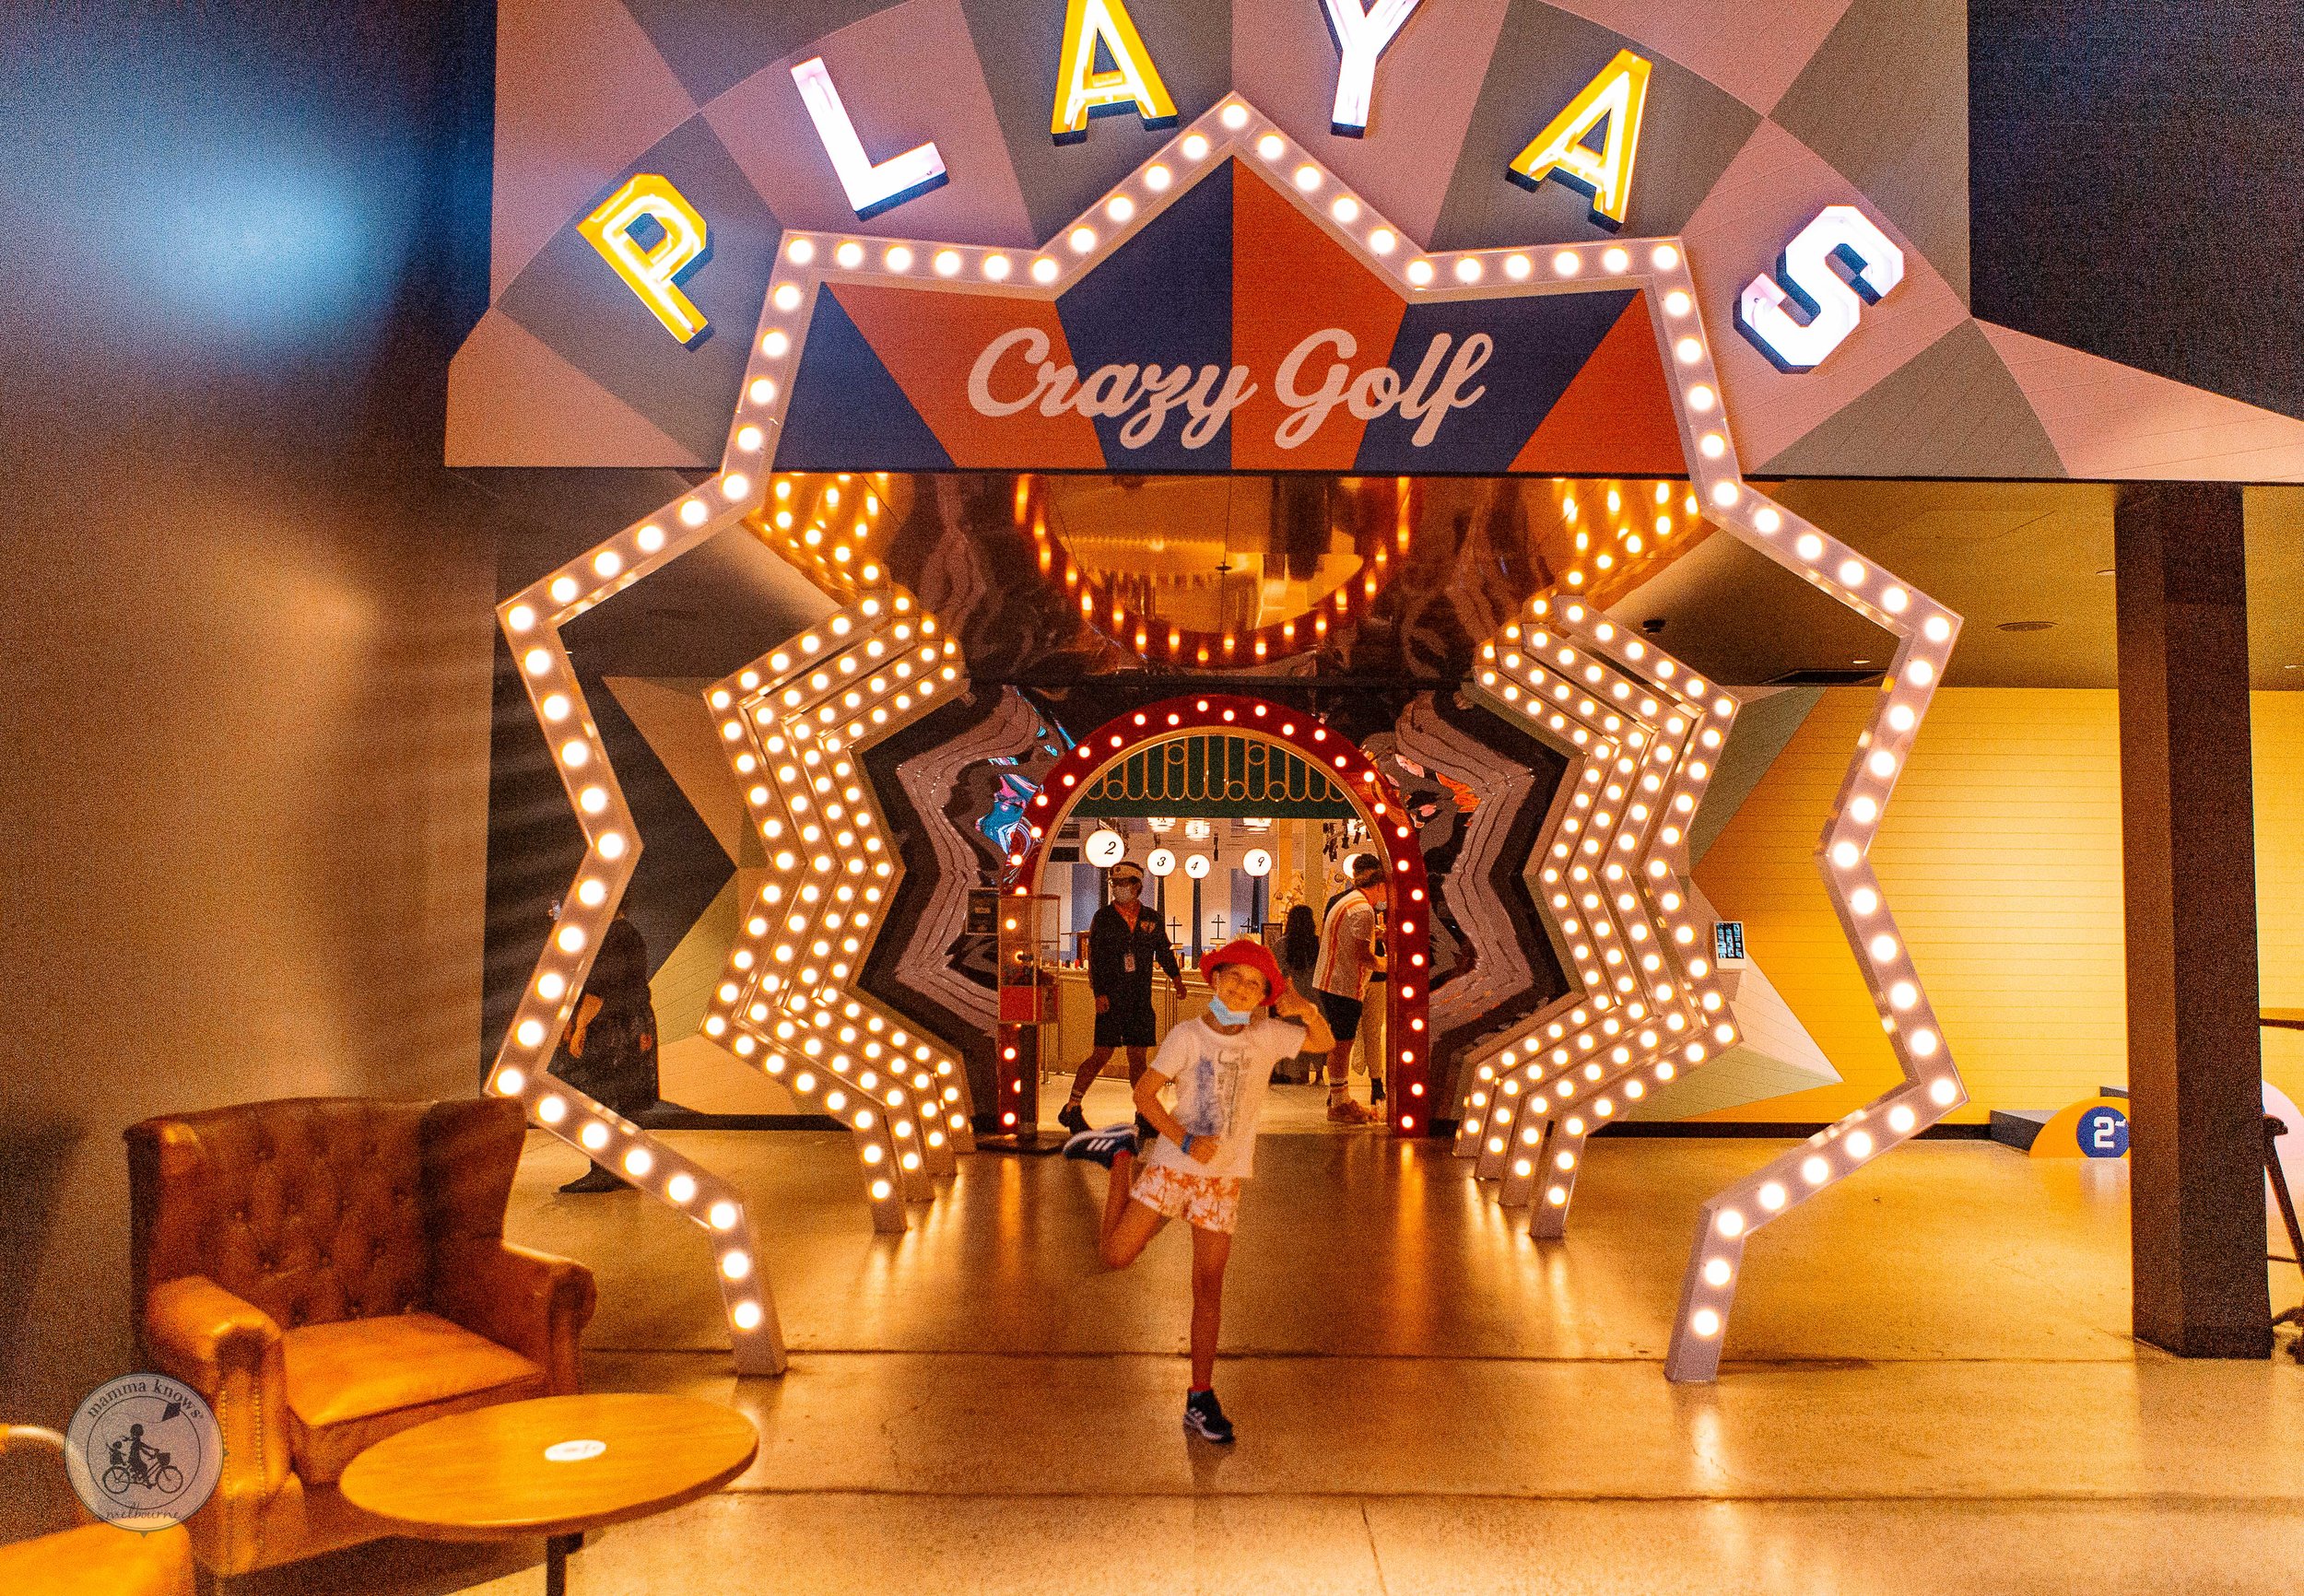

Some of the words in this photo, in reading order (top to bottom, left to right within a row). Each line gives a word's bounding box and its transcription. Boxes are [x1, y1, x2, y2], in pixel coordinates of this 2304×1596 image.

[576, 0, 1907, 372] PLAYAS
[968, 327, 1259, 450] Crazy
[1274, 328, 1493, 449] Golf
[1104, 841, 1117, 855] 2
[1157, 857, 1167, 867] 3
